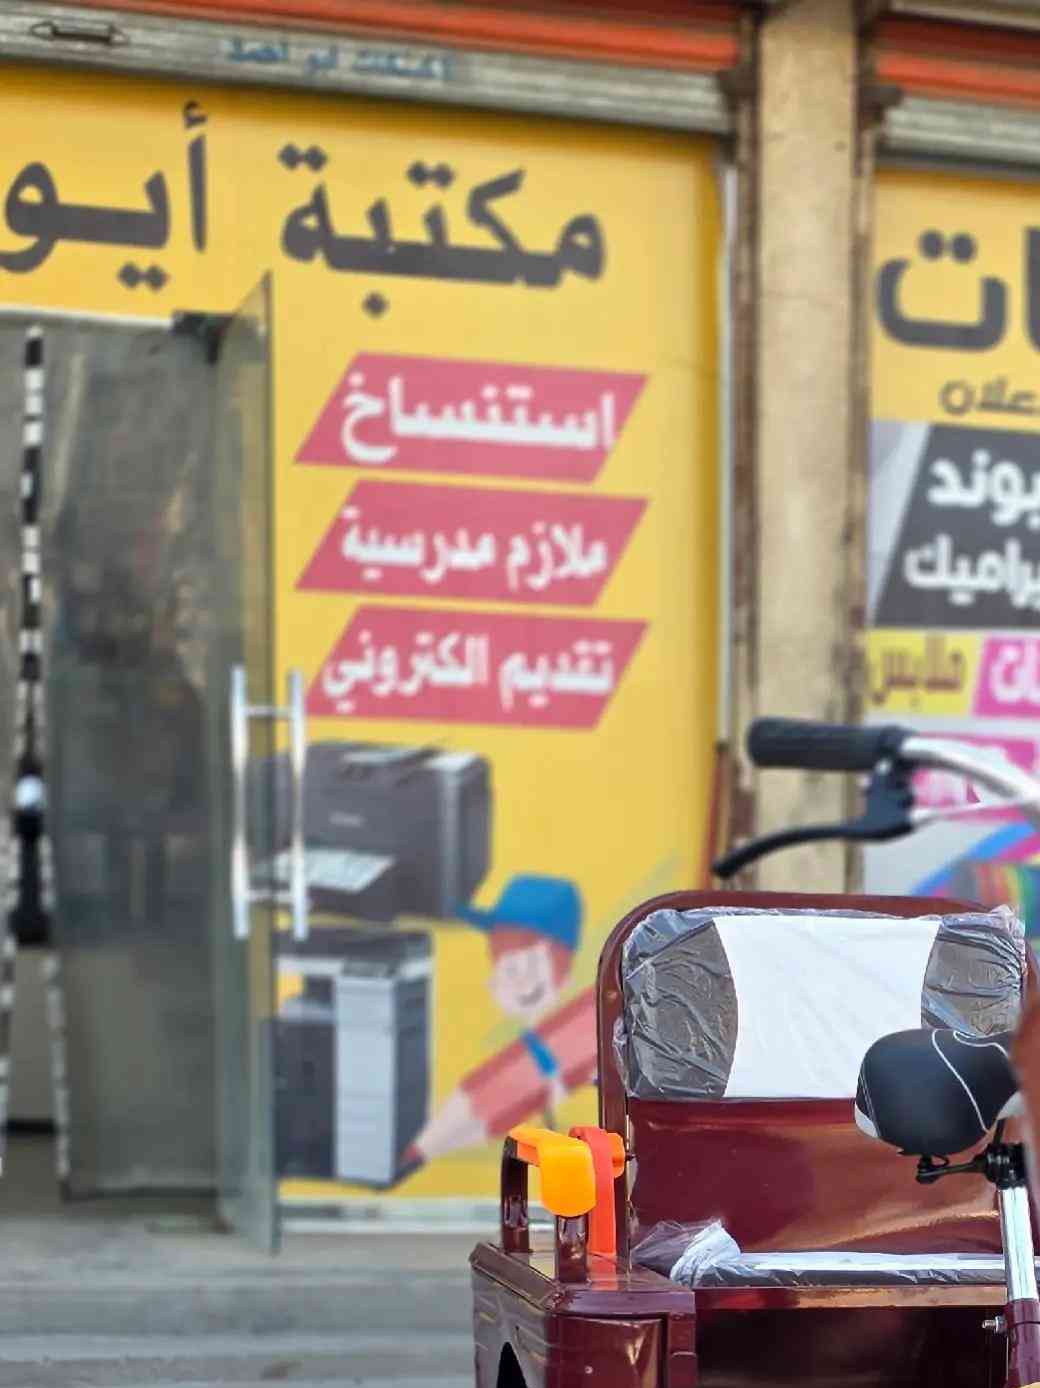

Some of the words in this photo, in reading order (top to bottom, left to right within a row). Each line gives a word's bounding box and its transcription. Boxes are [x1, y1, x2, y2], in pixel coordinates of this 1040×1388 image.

[278, 142, 607, 318] مكتبة
[341, 371, 614, 463] استنساخ
[341, 505, 496, 584] مدرسية
[506, 521, 608, 592] ملازم
[321, 629, 489, 714] الكتروني
[500, 639, 614, 713] تقديم
